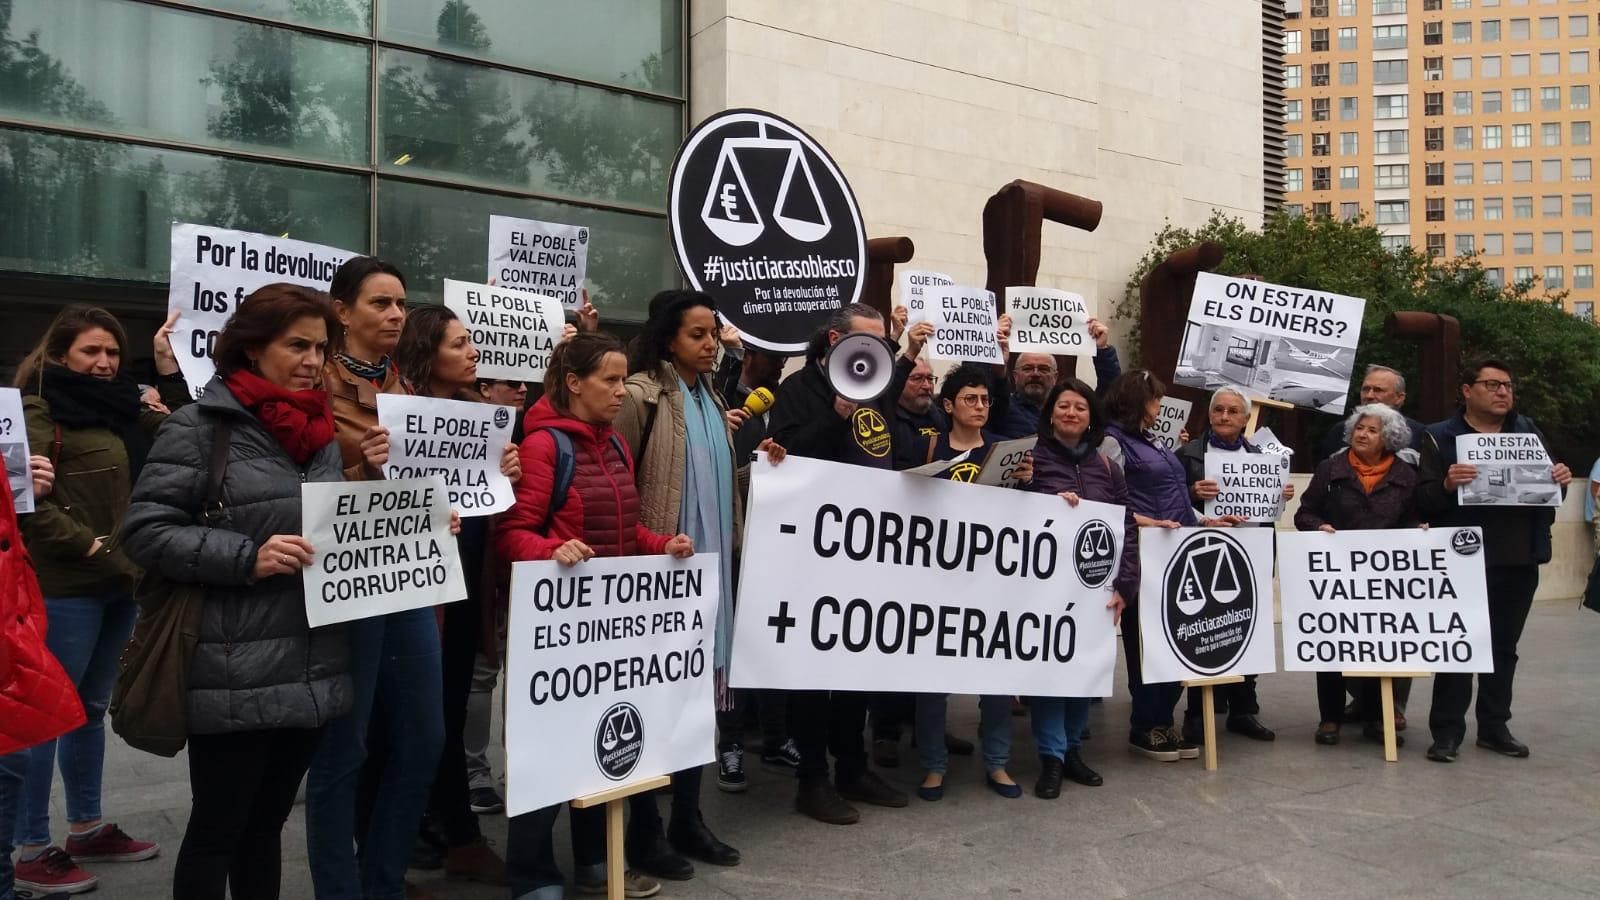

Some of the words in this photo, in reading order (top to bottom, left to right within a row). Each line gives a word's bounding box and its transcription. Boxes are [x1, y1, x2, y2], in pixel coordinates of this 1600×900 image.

[511, 231, 528, 247] EL
[533, 234, 576, 252] POBLE
[197, 235, 235, 267] Por
[241, 241, 259, 271] la
[509, 249, 577, 268] VALENCIÀ
[501, 268, 556, 287] CONTRA
[560, 273, 577, 288] LA
[703, 254, 855, 287] #justiciacasoblasco
[910, 275, 930, 285] QUE
[193, 282, 228, 313] los
[467, 291, 486, 306] EL
[491, 294, 543, 314] POBLE
[755, 287, 771, 300] Por
[773, 286, 781, 299] la
[783, 285, 824, 300] devolución
[826, 284, 839, 298] del
[1226, 282, 1257, 301] ON
[1262, 289, 1334, 314] ESTAN
[743, 302, 773, 315] dinero
[774, 303, 793, 315] para
[793, 299, 841, 313] cooperación
[942, 297, 958, 308] EL
[961, 297, 990, 312] POBLE
[1012, 297, 1085, 314] #JUSTICIA
[467, 310, 548, 332] VALENCIÀ
[943, 311, 992, 326] VALENCIÀ
[1029, 314, 1073, 329] CASO
[1204, 300, 1243, 321] ELS
[1249, 306, 1348, 339] DINERS?
[534, 334, 553, 351] LA
[937, 328, 984, 343] CONTRA
[985, 332, 995, 344] LA
[1017, 330, 1082, 346] BLASCO
[936, 343, 997, 358] CORRUPCIÓ
[406, 414, 427, 434] EL
[433, 416, 491, 438] POBLE
[404, 439, 488, 461] VALENCIÀ
[1477, 437, 1495, 447] ON
[1500, 437, 1539, 447] ESTAN
[1468, 450, 1491, 460] ELS
[466, 469, 488, 487] LA
[1223, 463, 1238, 474] EL
[1242, 463, 1280, 475] POBLE
[1222, 475, 1282, 488] VALENCIÀ
[336, 495, 361, 516] EL
[368, 488, 434, 513] POBLE
[1216, 492, 1270, 504] CONTRA
[333, 509, 431, 544] VALENCIÀ
[813, 504, 1058, 580] CORRUPCIÓ
[324, 543, 410, 574] CONTRA
[416, 539, 442, 560] LA
[1308, 551, 1341, 573] EL
[1351, 549, 1447, 572] POBLE
[322, 559, 446, 603] CORRUPCIÓ
[533, 575, 593, 613] QUE
[601, 569, 702, 605] TORNEN
[1310, 571, 1457, 600] VALENCIÀ
[534, 623, 571, 650] ELS
[577, 615, 646, 644] DINERS
[651, 611, 686, 635] PER
[692, 609, 703, 630] A
[810, 596, 1076, 663] COOPERACIÓ
[1177, 608, 1251, 641] #justiciacasoblasco
[1298, 612, 1420, 634] CONTRA
[1429, 612, 1467, 633] LA
[1296, 634, 1473, 662] CORRUPCIÓ
[530, 640, 705, 706] COOPERACIÓ
